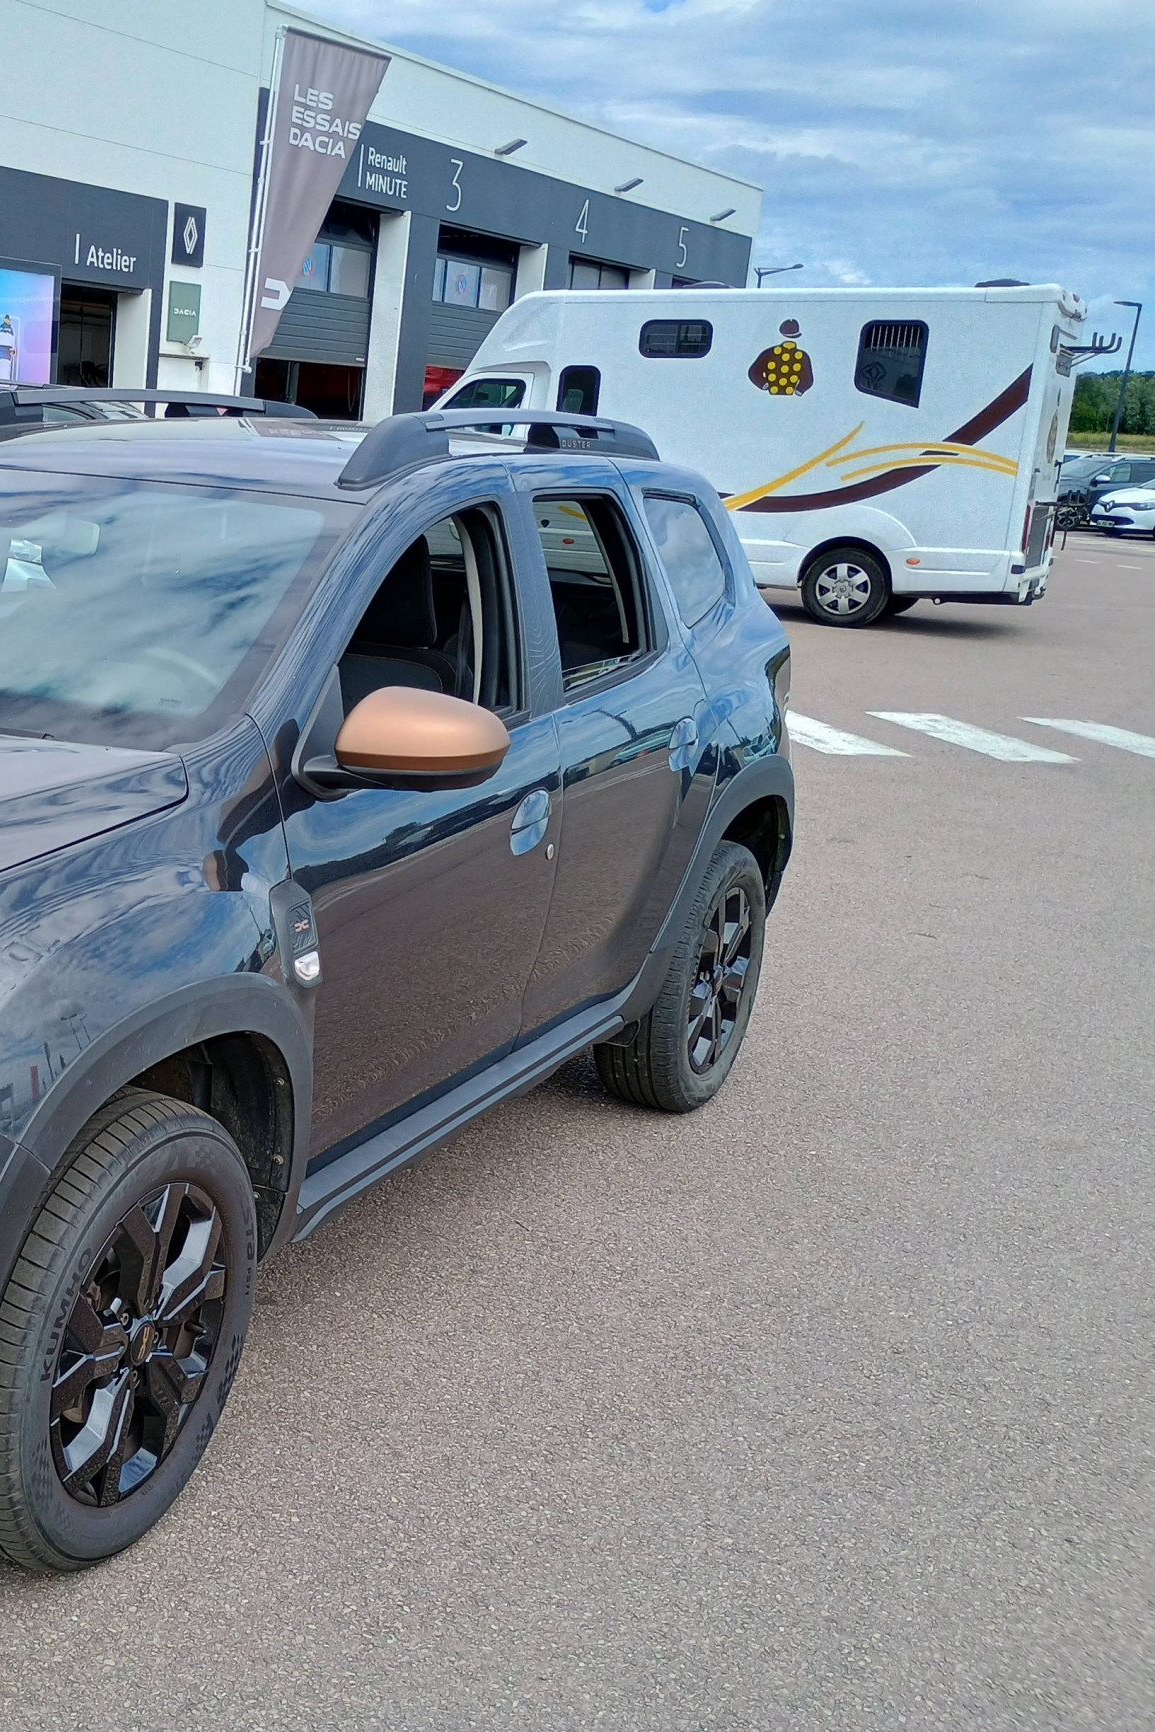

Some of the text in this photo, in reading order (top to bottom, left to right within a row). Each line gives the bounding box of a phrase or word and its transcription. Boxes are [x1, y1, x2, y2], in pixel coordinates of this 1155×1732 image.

[293, 84, 334, 111] LES
[291, 105, 362, 140] ESSAIS
[289, 127, 346, 159] DACIA
[367, 146, 407, 175] Renault
[365, 171, 408, 199] MINUTE
[446, 158, 463, 212] 3
[575, 199, 589, 243] 4
[86, 244, 137, 273] Atelier
[676, 226, 689, 268] 5
[173, 307, 197, 317] DACIA
[561, 439, 591, 449] DUSTER
[40, 1247, 92, 1382] KUMHO
